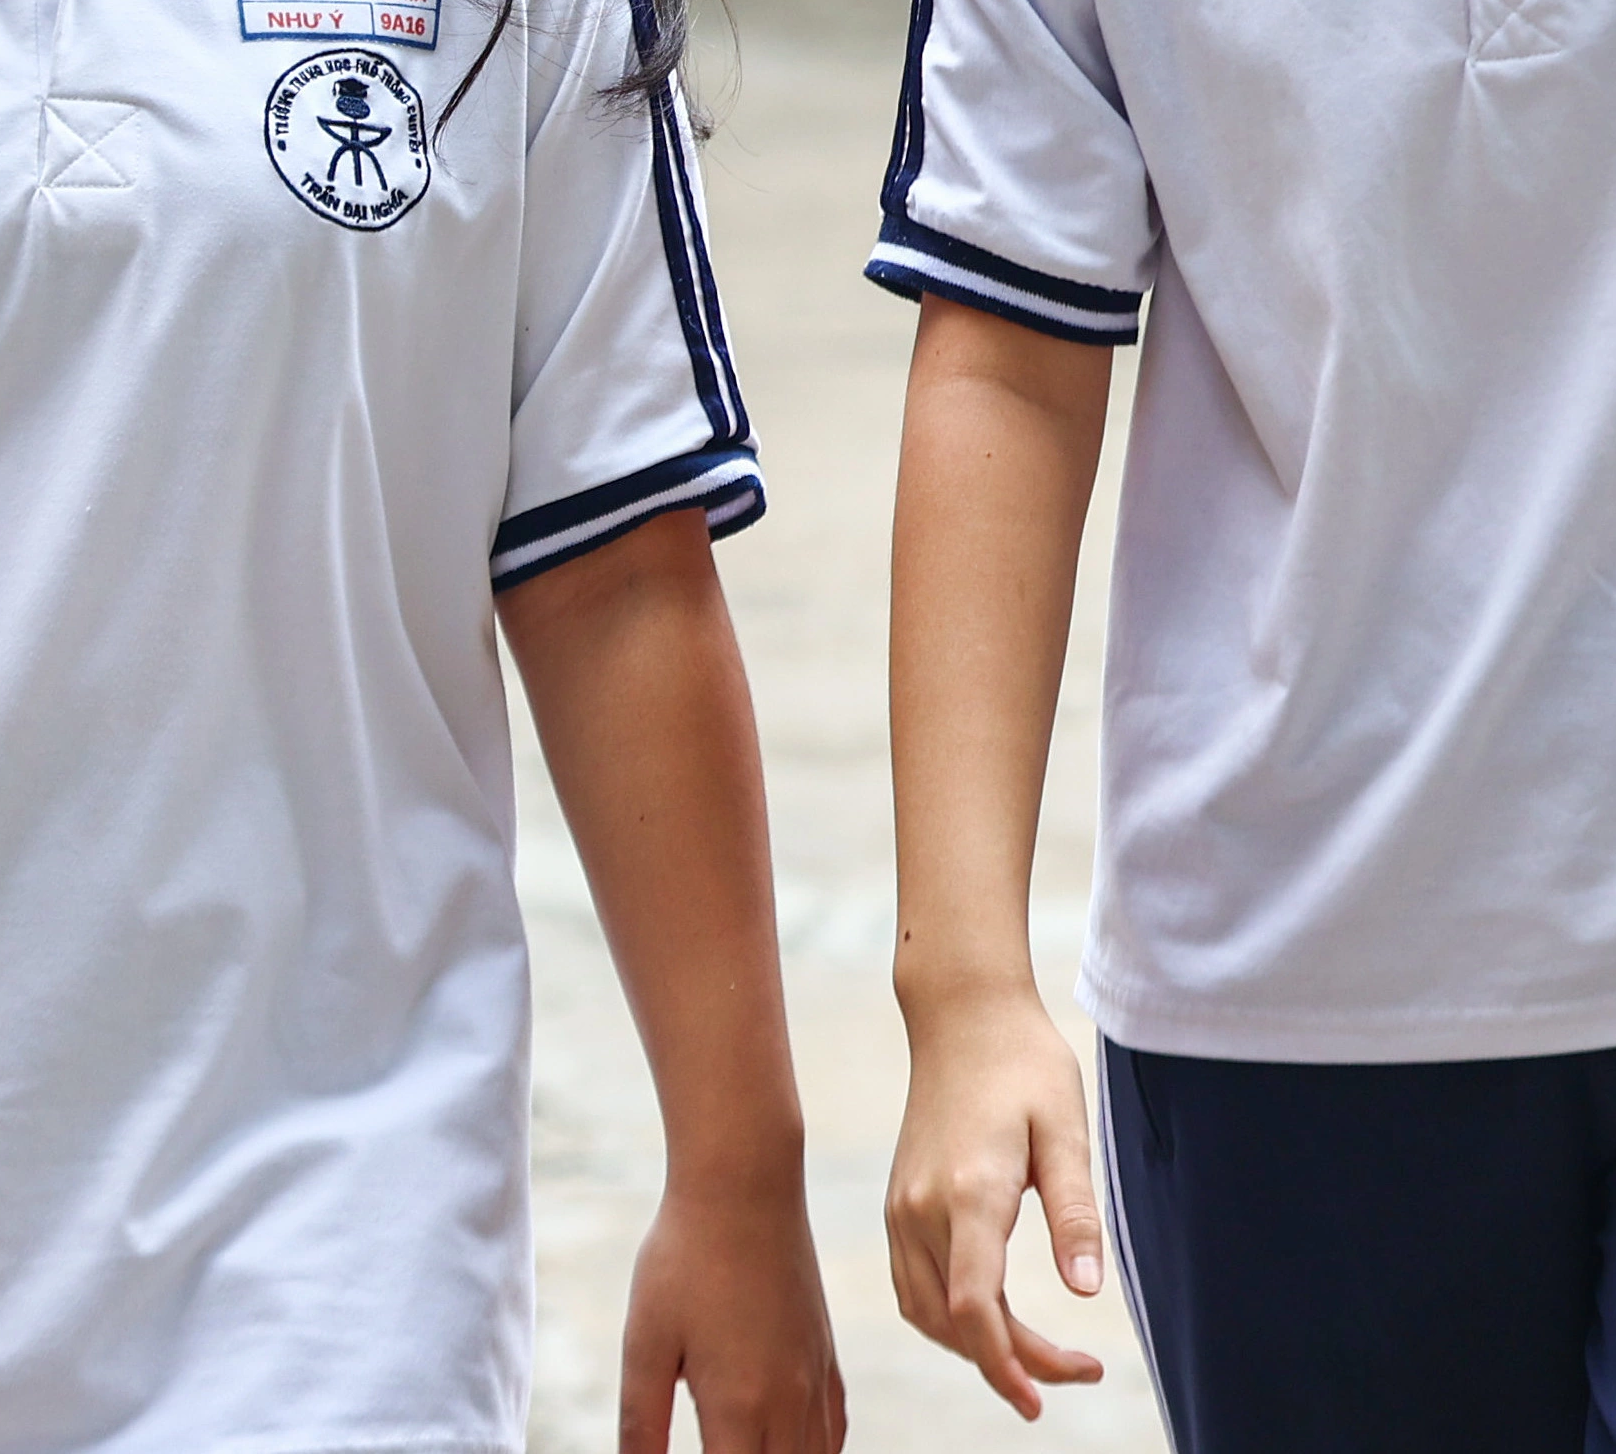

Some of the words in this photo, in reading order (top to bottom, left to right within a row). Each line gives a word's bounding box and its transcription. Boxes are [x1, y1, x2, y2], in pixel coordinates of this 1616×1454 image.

[268, 11, 322, 29] NHƯ
[329, 10, 344, 29] Ý
[380, 13, 426, 36] 9A16
